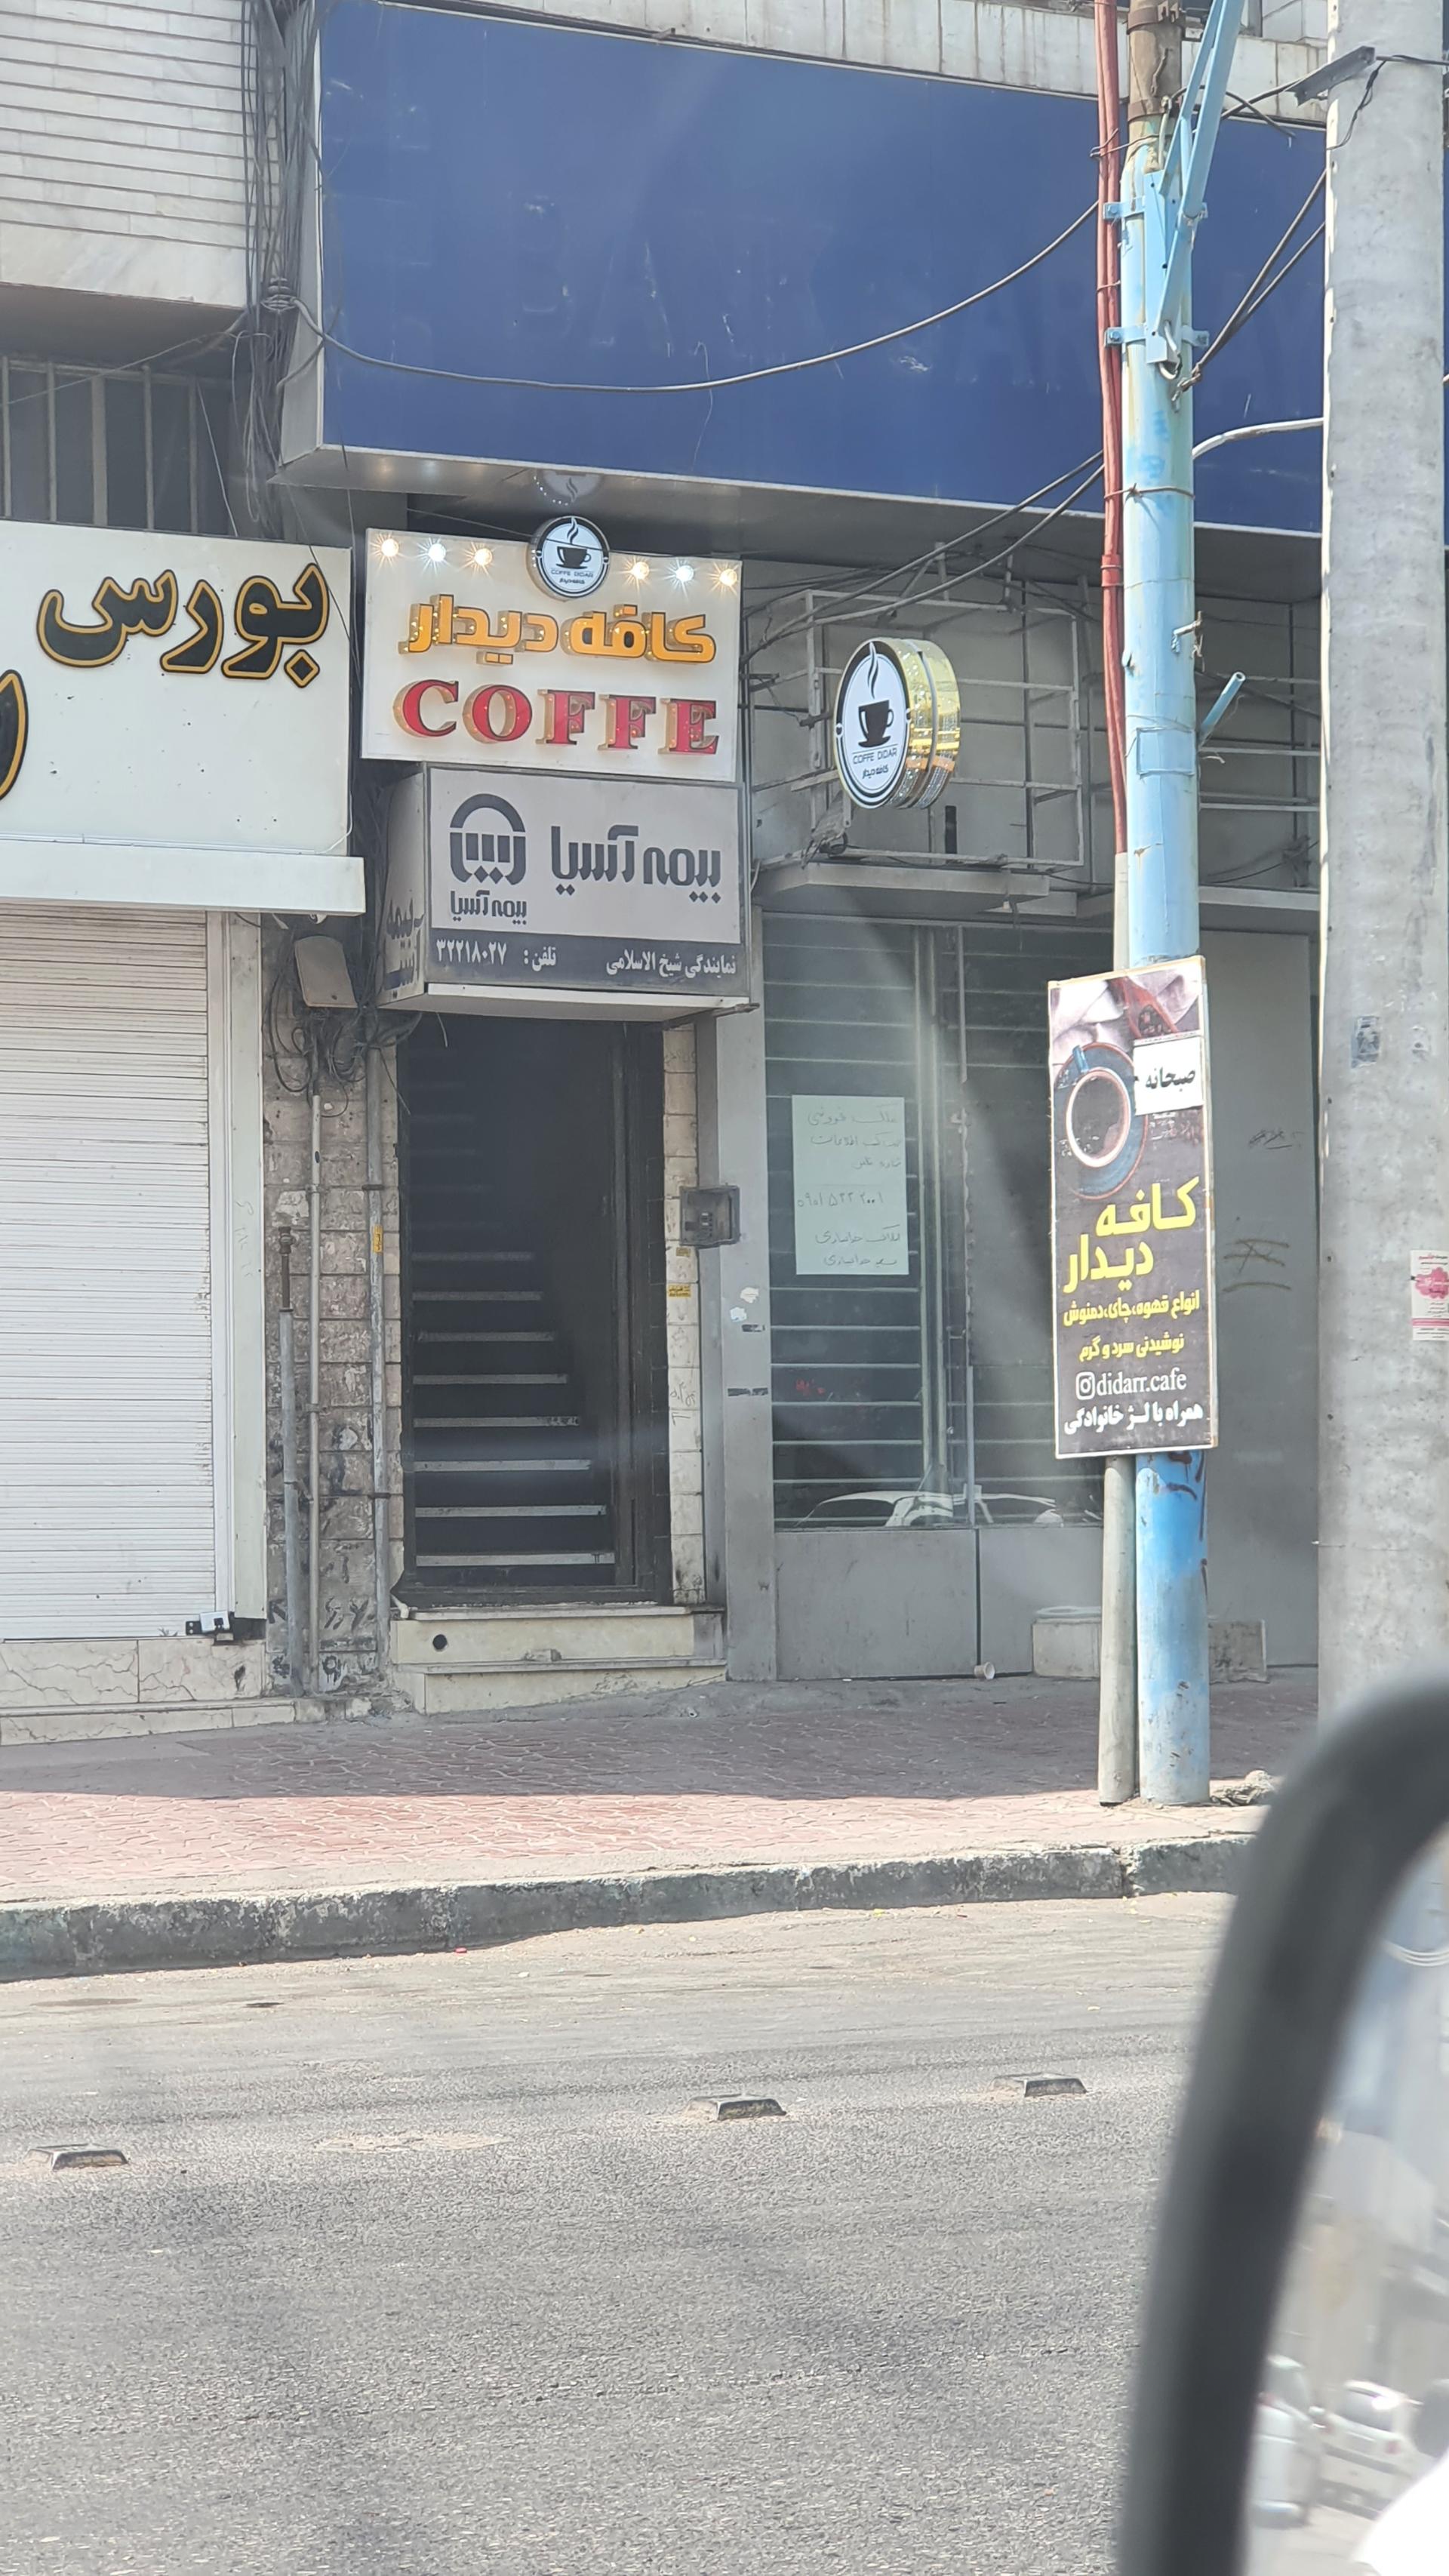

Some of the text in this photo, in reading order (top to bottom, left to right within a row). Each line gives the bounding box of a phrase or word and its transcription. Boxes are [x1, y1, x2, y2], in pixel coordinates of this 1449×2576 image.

[37, 562, 329, 688] بورس
[399, 594, 717, 665] کافه دیدار
[393, 679, 719, 755] COFFE
[853, 747, 898, 765] COFFE DIDAR
[551, 824, 722, 903] بیمه آسیا
[451, 889, 528, 925] بیمه آسیا
[435, 939, 508, 965] ۳۲۲۱۸۰۲۷
[605, 949, 737, 979] نمایندگی شیخ الاسلامی
[1146, 1066, 1196, 1092] صبحانه
[1096, 1176, 1200, 1236] کافه
[1063, 1234, 1154, 1294] دیدار
[1171, 1290, 1200, 1319] انواع
[1079, 1331, 1185, 1362] نوشیدنی سرد و گرم
[1097, 1367, 1187, 1396] didarr.cafe
[1064, 1404, 1124, 1435] خانوادگی
[1152, 1402, 1163, 1426] با
[1165, 1400, 1204, 1427] همراه
